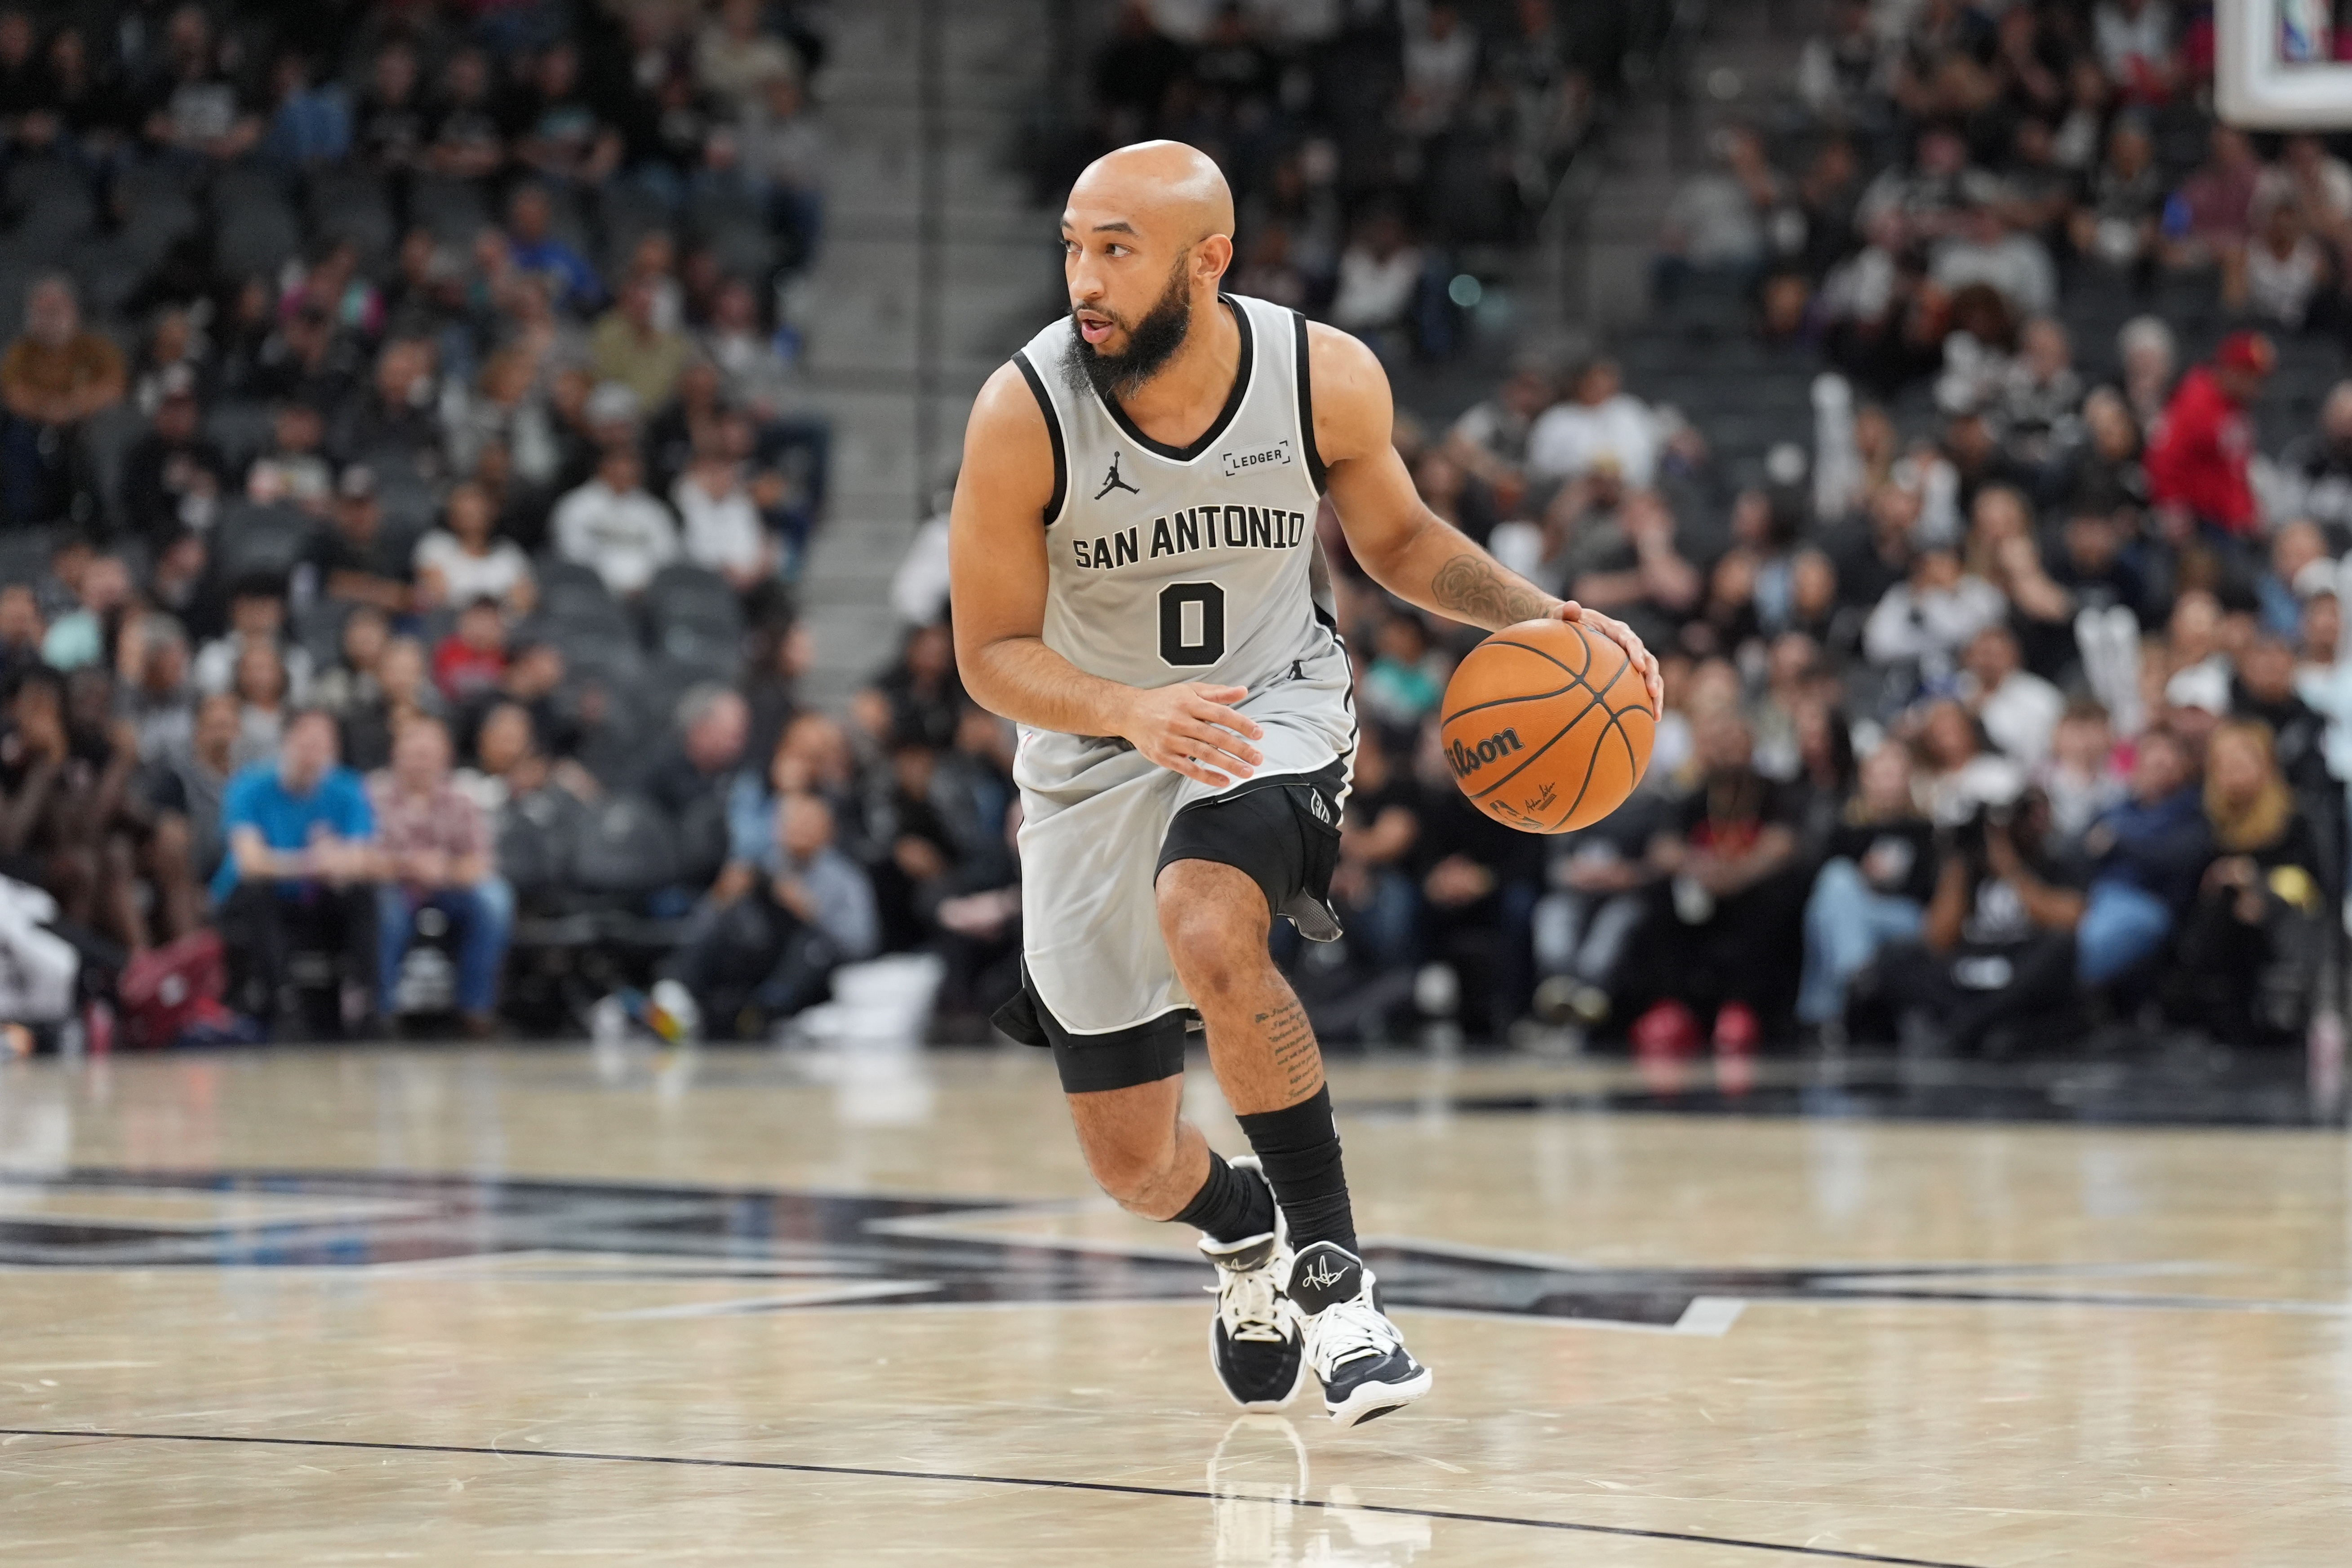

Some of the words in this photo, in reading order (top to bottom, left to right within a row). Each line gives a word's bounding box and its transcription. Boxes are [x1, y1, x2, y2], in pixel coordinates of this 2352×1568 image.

[1233, 449, 1281, 468] LEDGER
[1072, 524, 1140, 570] SAN
[1148, 503, 1305, 560] ANTONIO
[1156, 580, 1227, 668] 0
[1444, 728, 1525, 781] ilson
